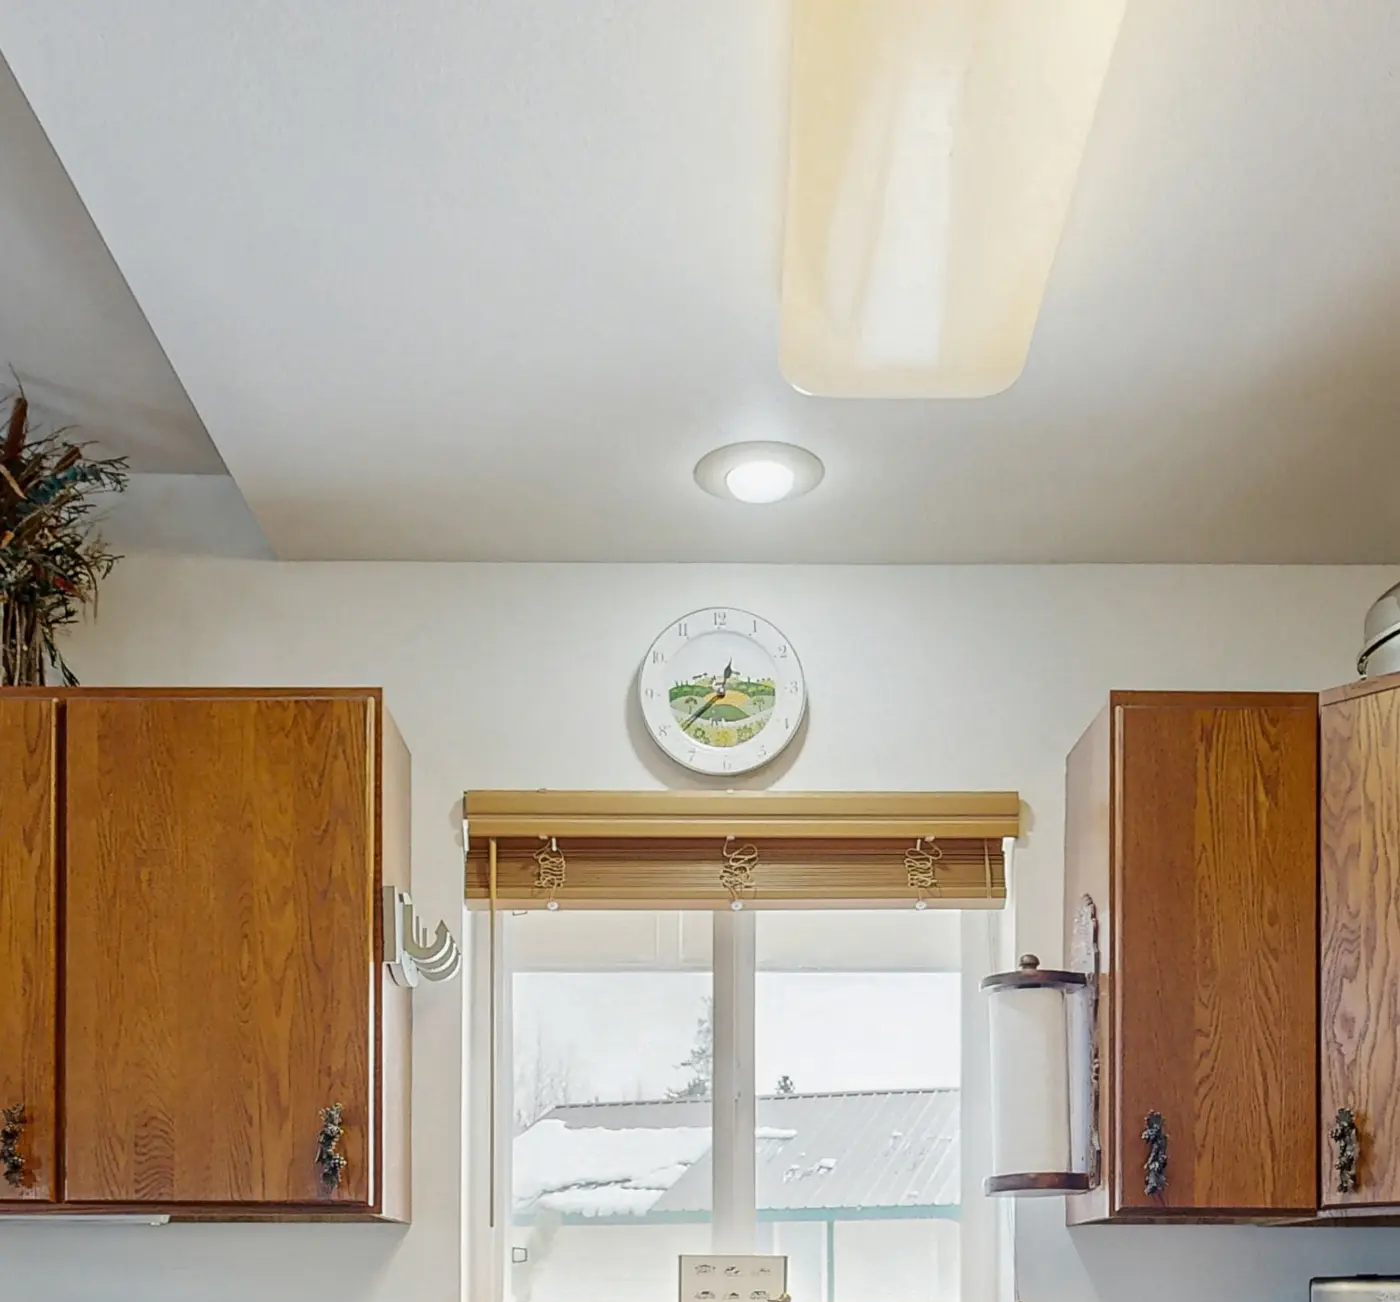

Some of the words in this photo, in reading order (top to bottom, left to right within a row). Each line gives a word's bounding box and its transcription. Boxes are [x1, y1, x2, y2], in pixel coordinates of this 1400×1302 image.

[713, 611, 727, 626] 12
[678, 622, 688, 637] 11
[752, 619, 757, 633] 1
[652, 650, 665, 664] 10
[778, 645, 788, 659] 2
[789, 680, 799, 694] 3
[687, 747, 697, 762] 7
